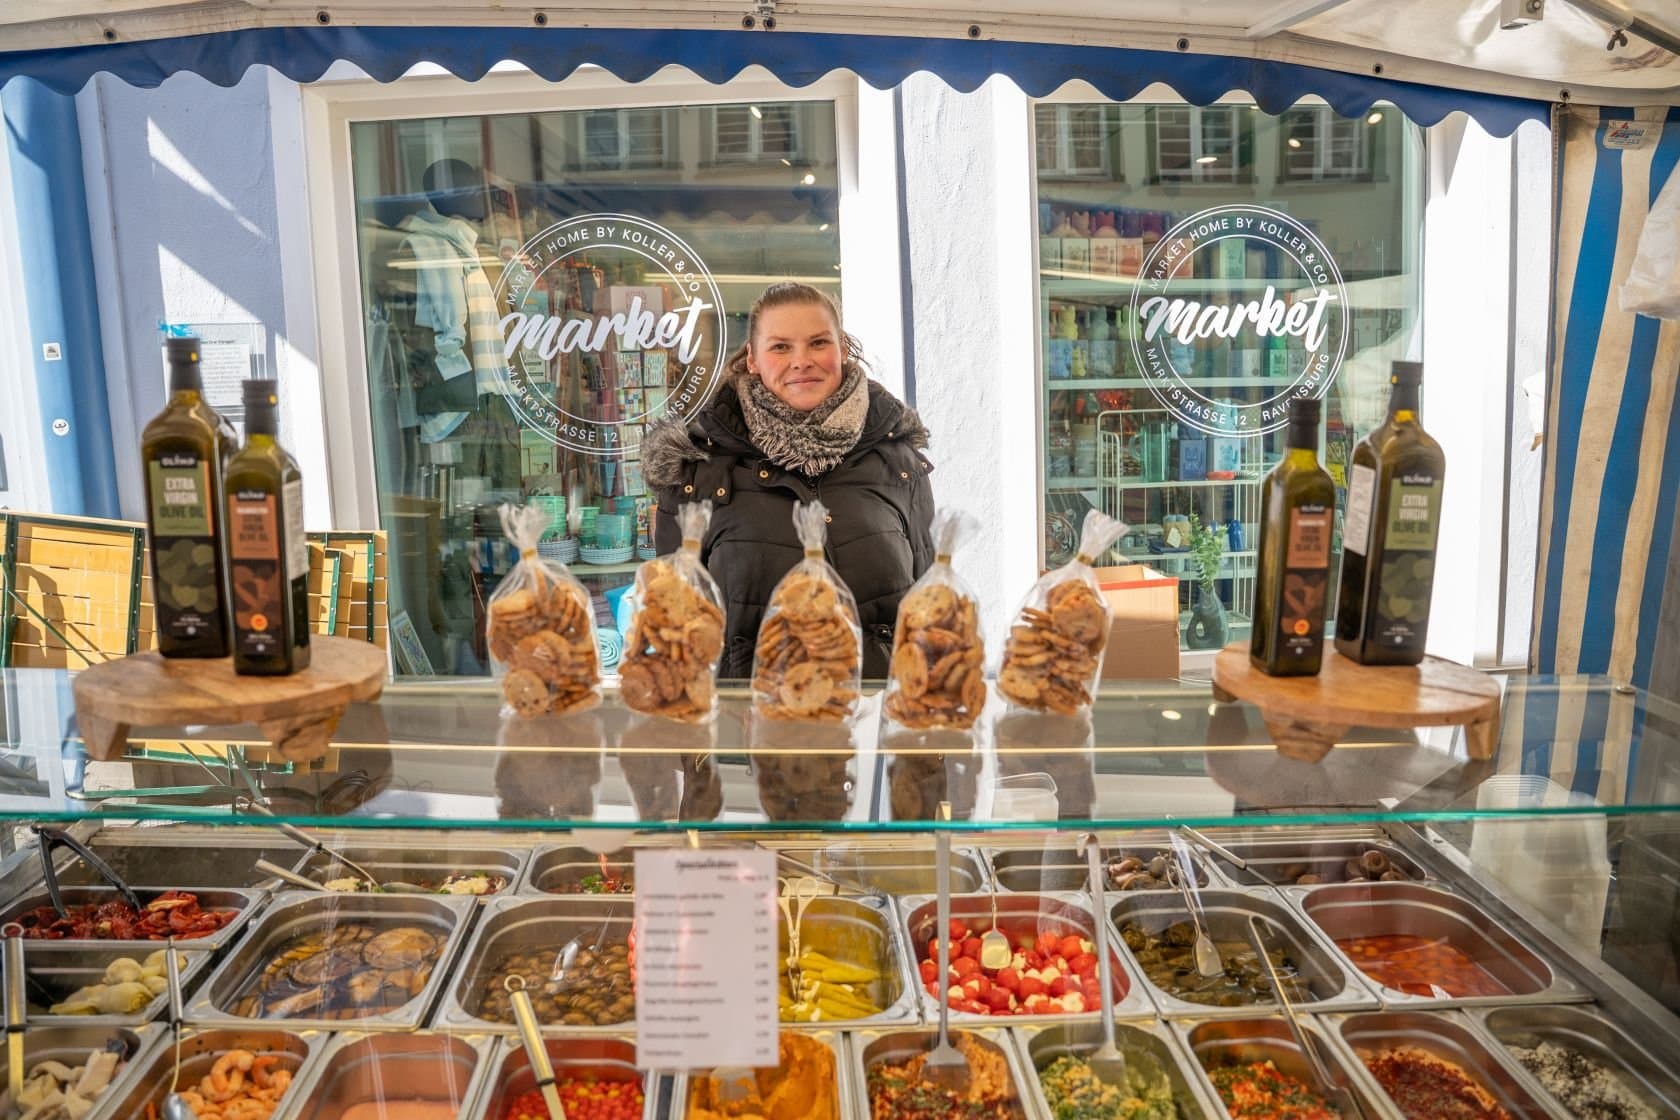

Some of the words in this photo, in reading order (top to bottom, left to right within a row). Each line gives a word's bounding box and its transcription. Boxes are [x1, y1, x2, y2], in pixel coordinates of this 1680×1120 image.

[504, 250, 545, 306] MARKET
[546, 227, 590, 254] HOME
[596, 226, 616, 239] BY
[622, 228, 676, 263] KOLLER
[674, 260, 686, 273] &
[684, 272, 701, 292] CO
[1149, 238, 1187, 291] MARKET
[1189, 217, 1230, 242] HOME
[1235, 217, 1254, 229] BY
[1259, 220, 1307, 255] KOLLER
[1305, 252, 1316, 265] &
[1313, 264, 1328, 284] CO
[507, 364, 597, 442] MARKTSTRASSE
[603, 431, 618, 443] 12
[634, 365, 707, 436] RANSBURG
[1145, 347, 1227, 425] MARKTSTRASSE
[1233, 415, 1248, 426] 12
[165, 477, 196, 491] EXTRA
